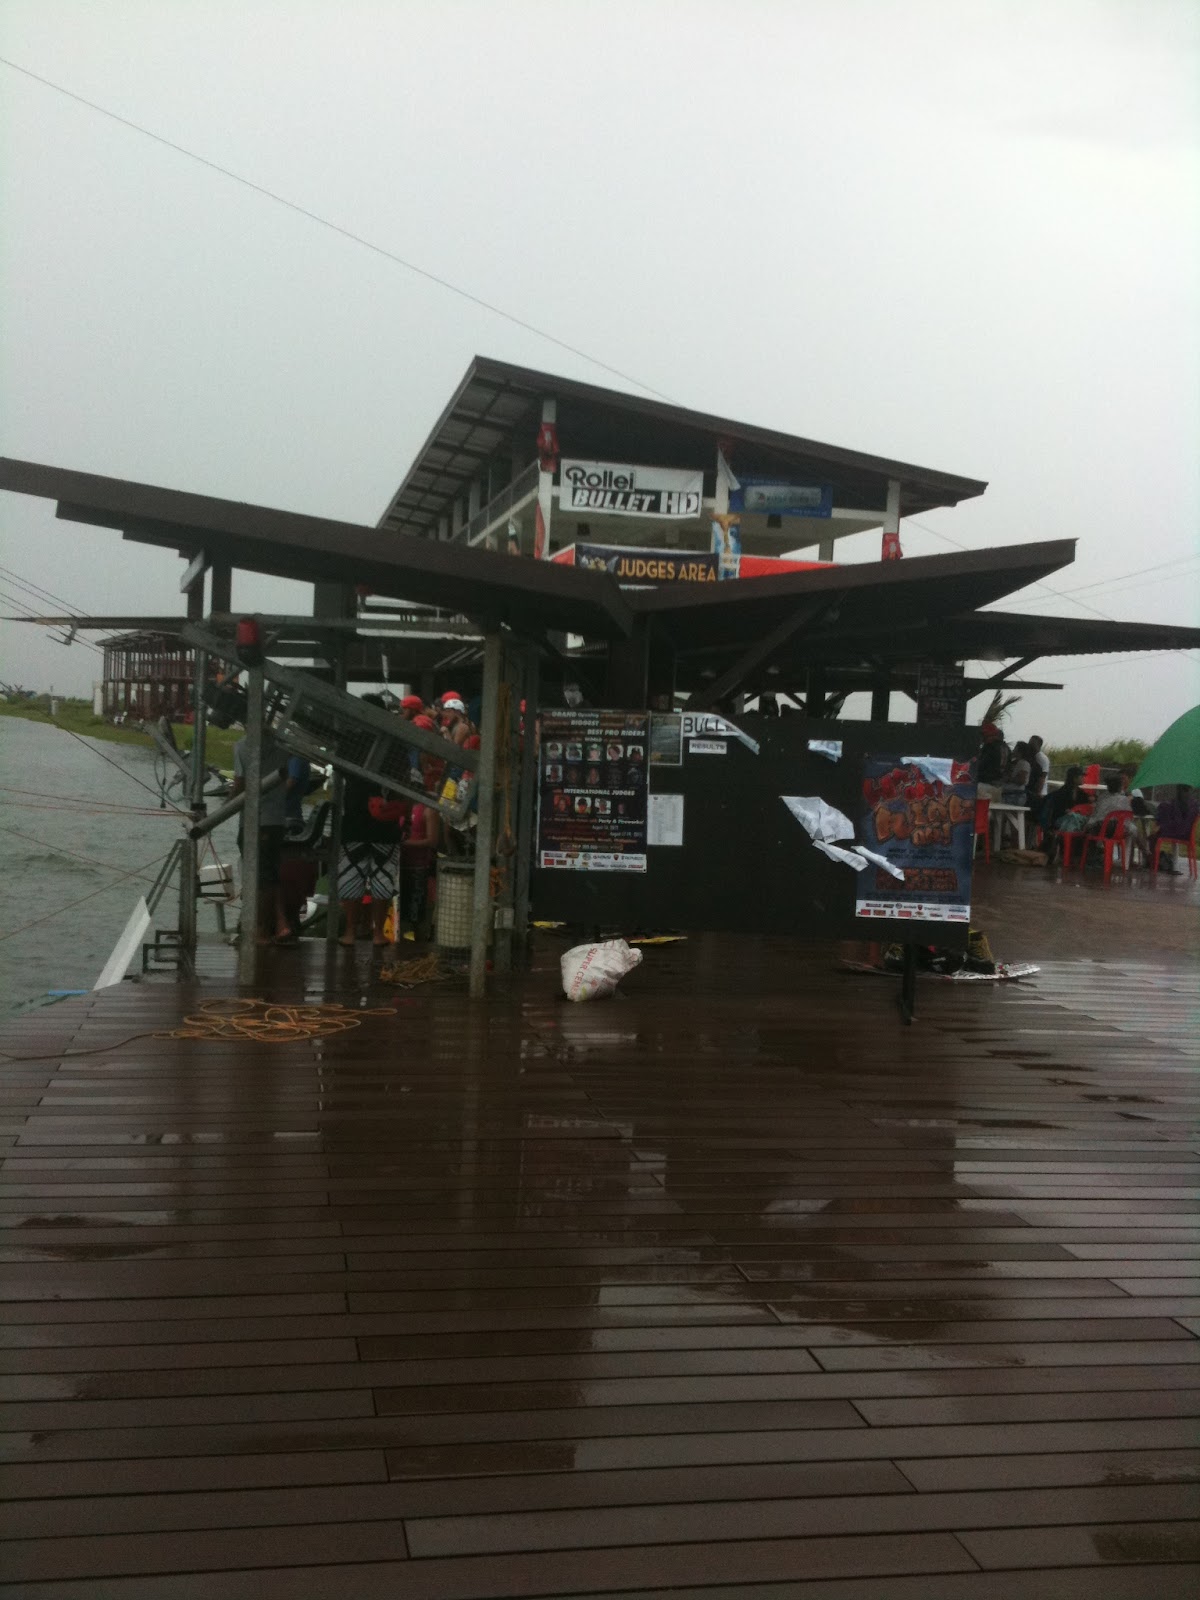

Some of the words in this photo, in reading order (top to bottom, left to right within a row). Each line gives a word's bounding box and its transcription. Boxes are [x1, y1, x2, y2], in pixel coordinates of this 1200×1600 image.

[565, 466, 635, 489] Rollei
[571, 488, 656, 512] BULLET
[658, 491, 700, 515] HD
[616, 557, 676, 580] JUDGES
[677, 563, 716, 581] AREA
[580, 947, 598, 971] SUPER
